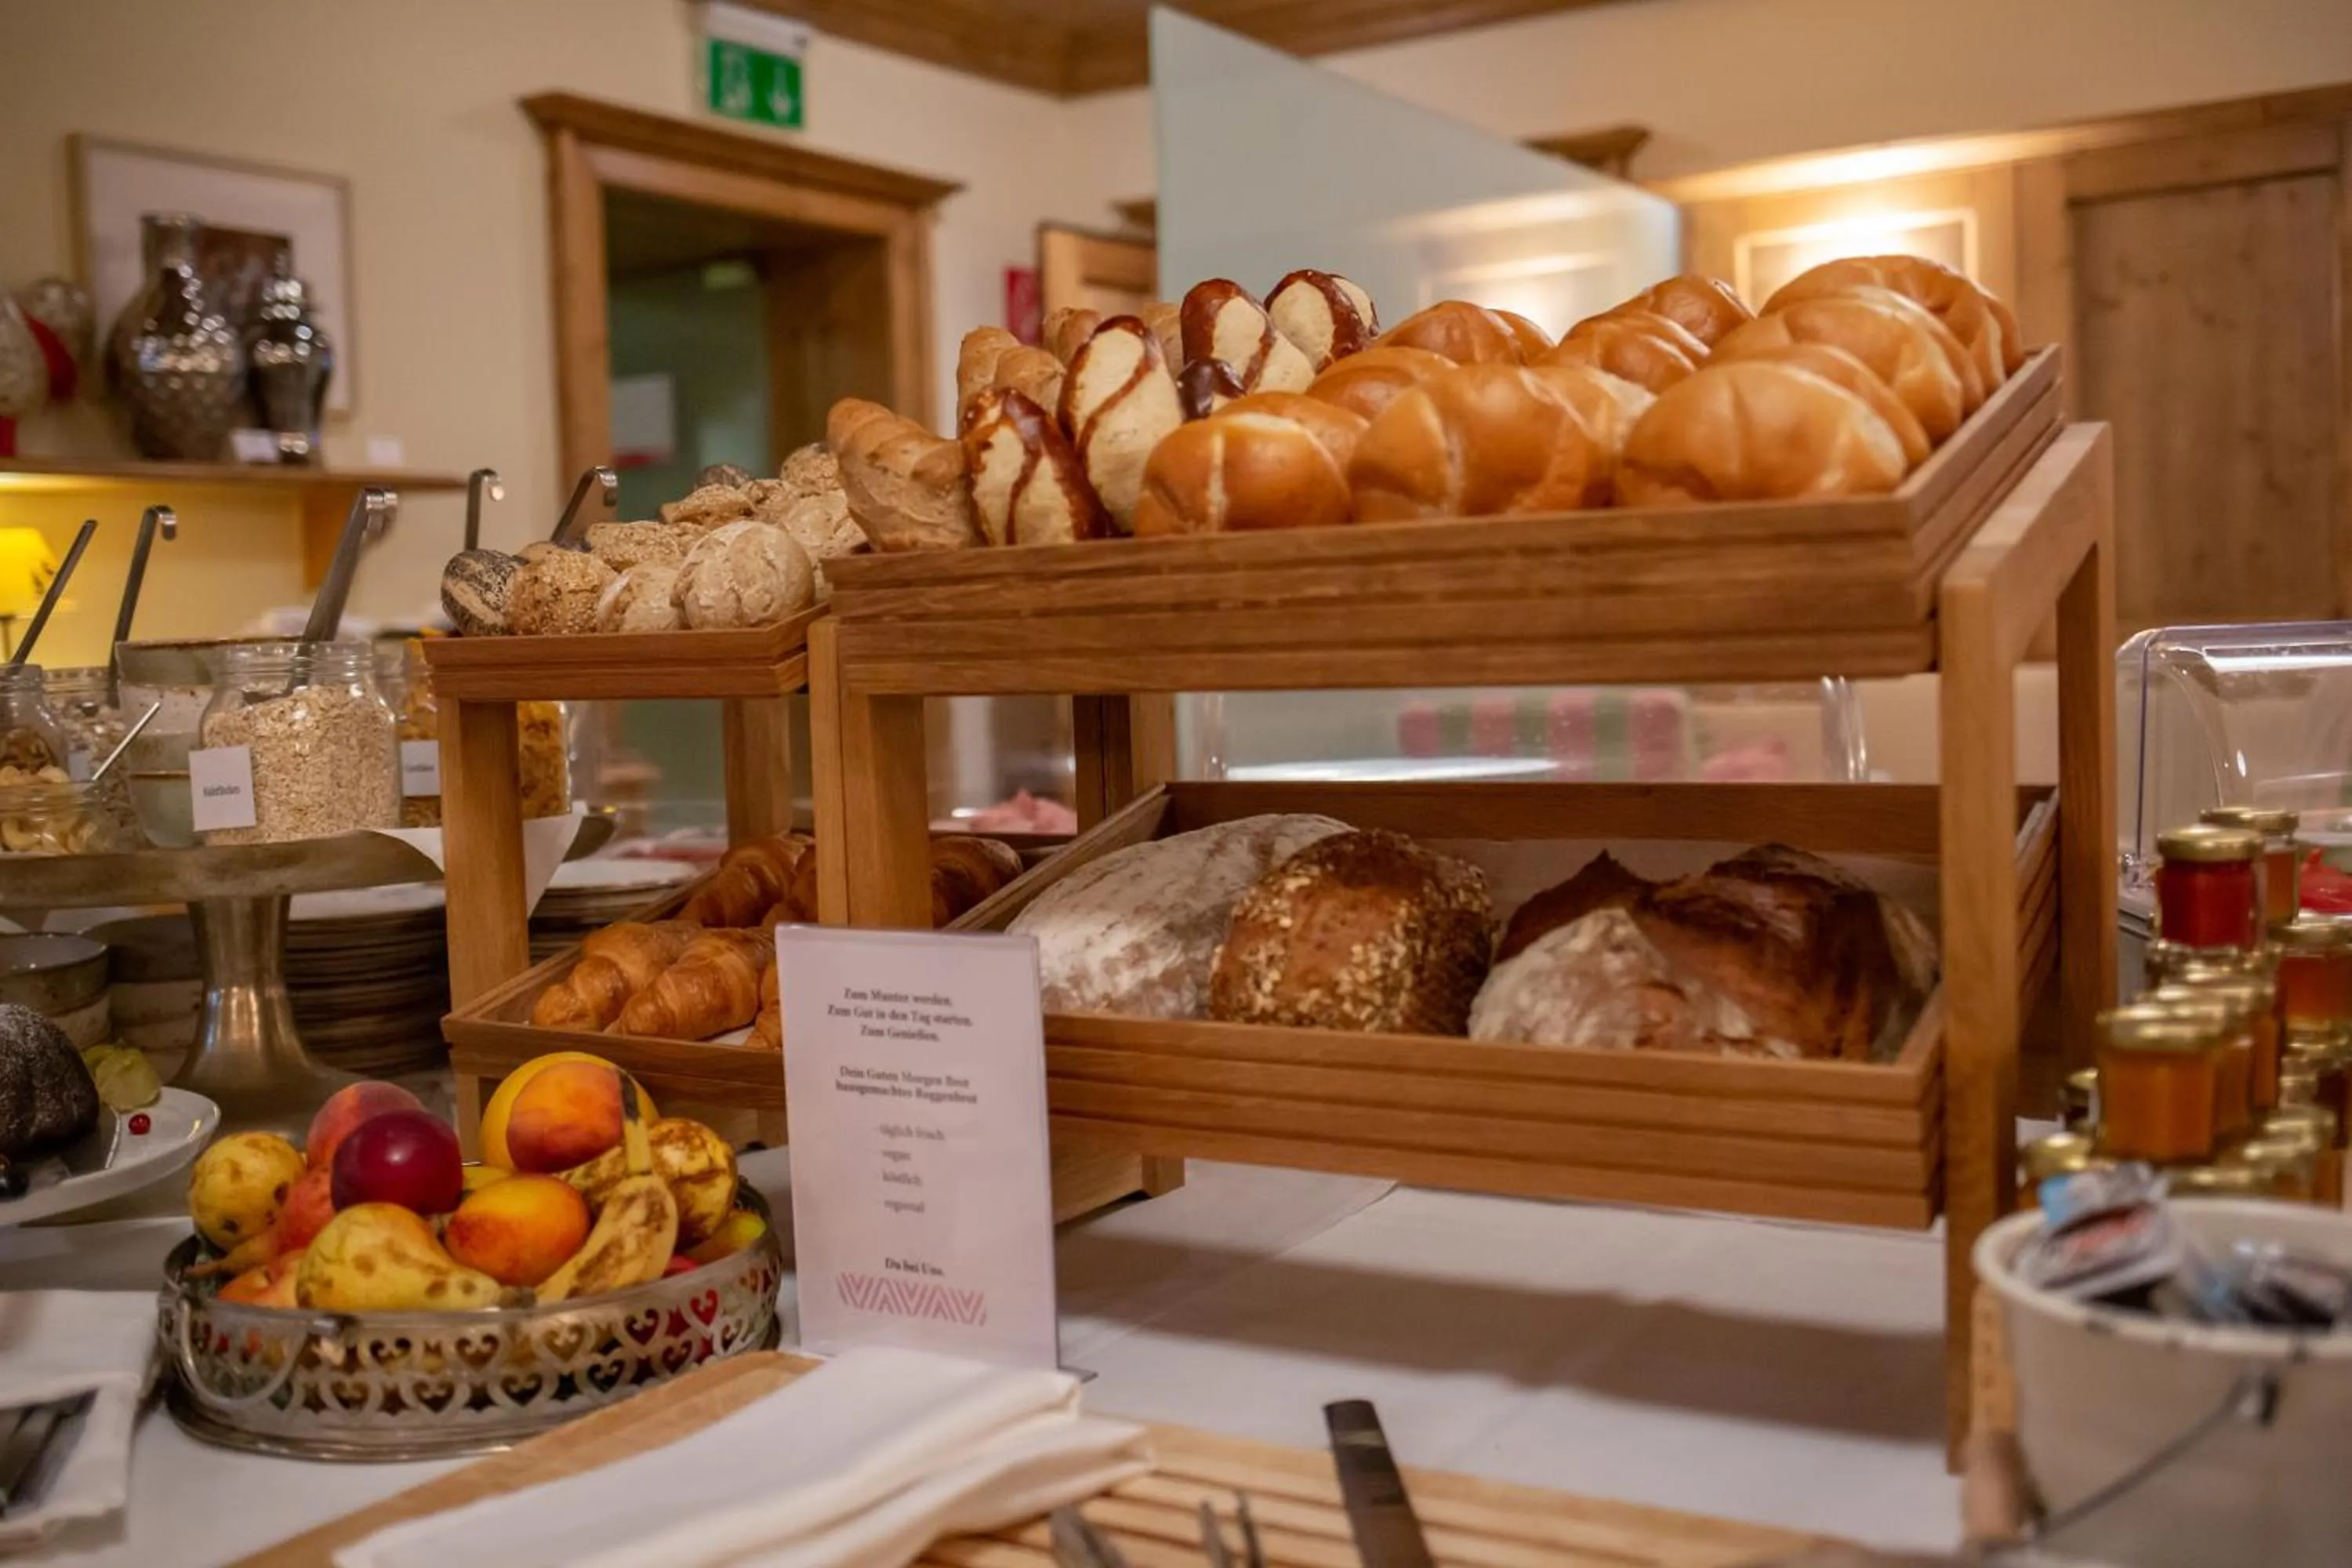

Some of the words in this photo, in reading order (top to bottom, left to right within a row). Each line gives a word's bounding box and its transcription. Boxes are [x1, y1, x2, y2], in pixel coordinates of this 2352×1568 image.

[844, 988, 868, 1000] Zum
[827, 1004, 851, 1017] Zum
[876, 1009, 886, 1020] in
[889, 1010, 908, 1021] den
[911, 1011, 931, 1025] Tag
[861, 1024, 884, 1037] Zum
[902, 1071, 942, 1087] Morgen
